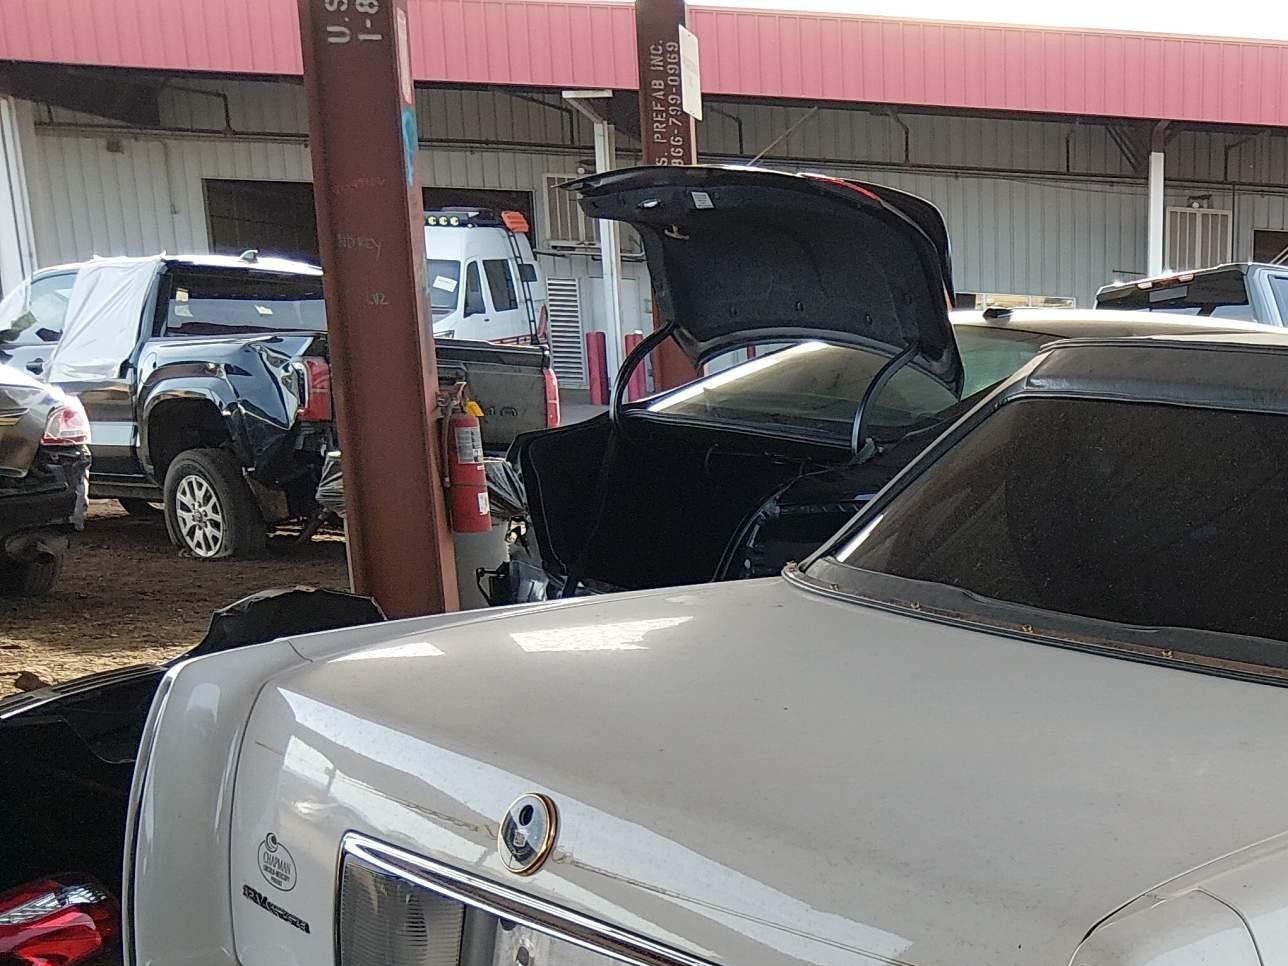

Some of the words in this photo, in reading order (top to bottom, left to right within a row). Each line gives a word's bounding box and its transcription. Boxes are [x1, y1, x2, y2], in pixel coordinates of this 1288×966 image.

[650, 39, 665, 71] INC.
[651, 79, 668, 143] PREFAB
[263, 851, 291, 876] CHAPMAN
